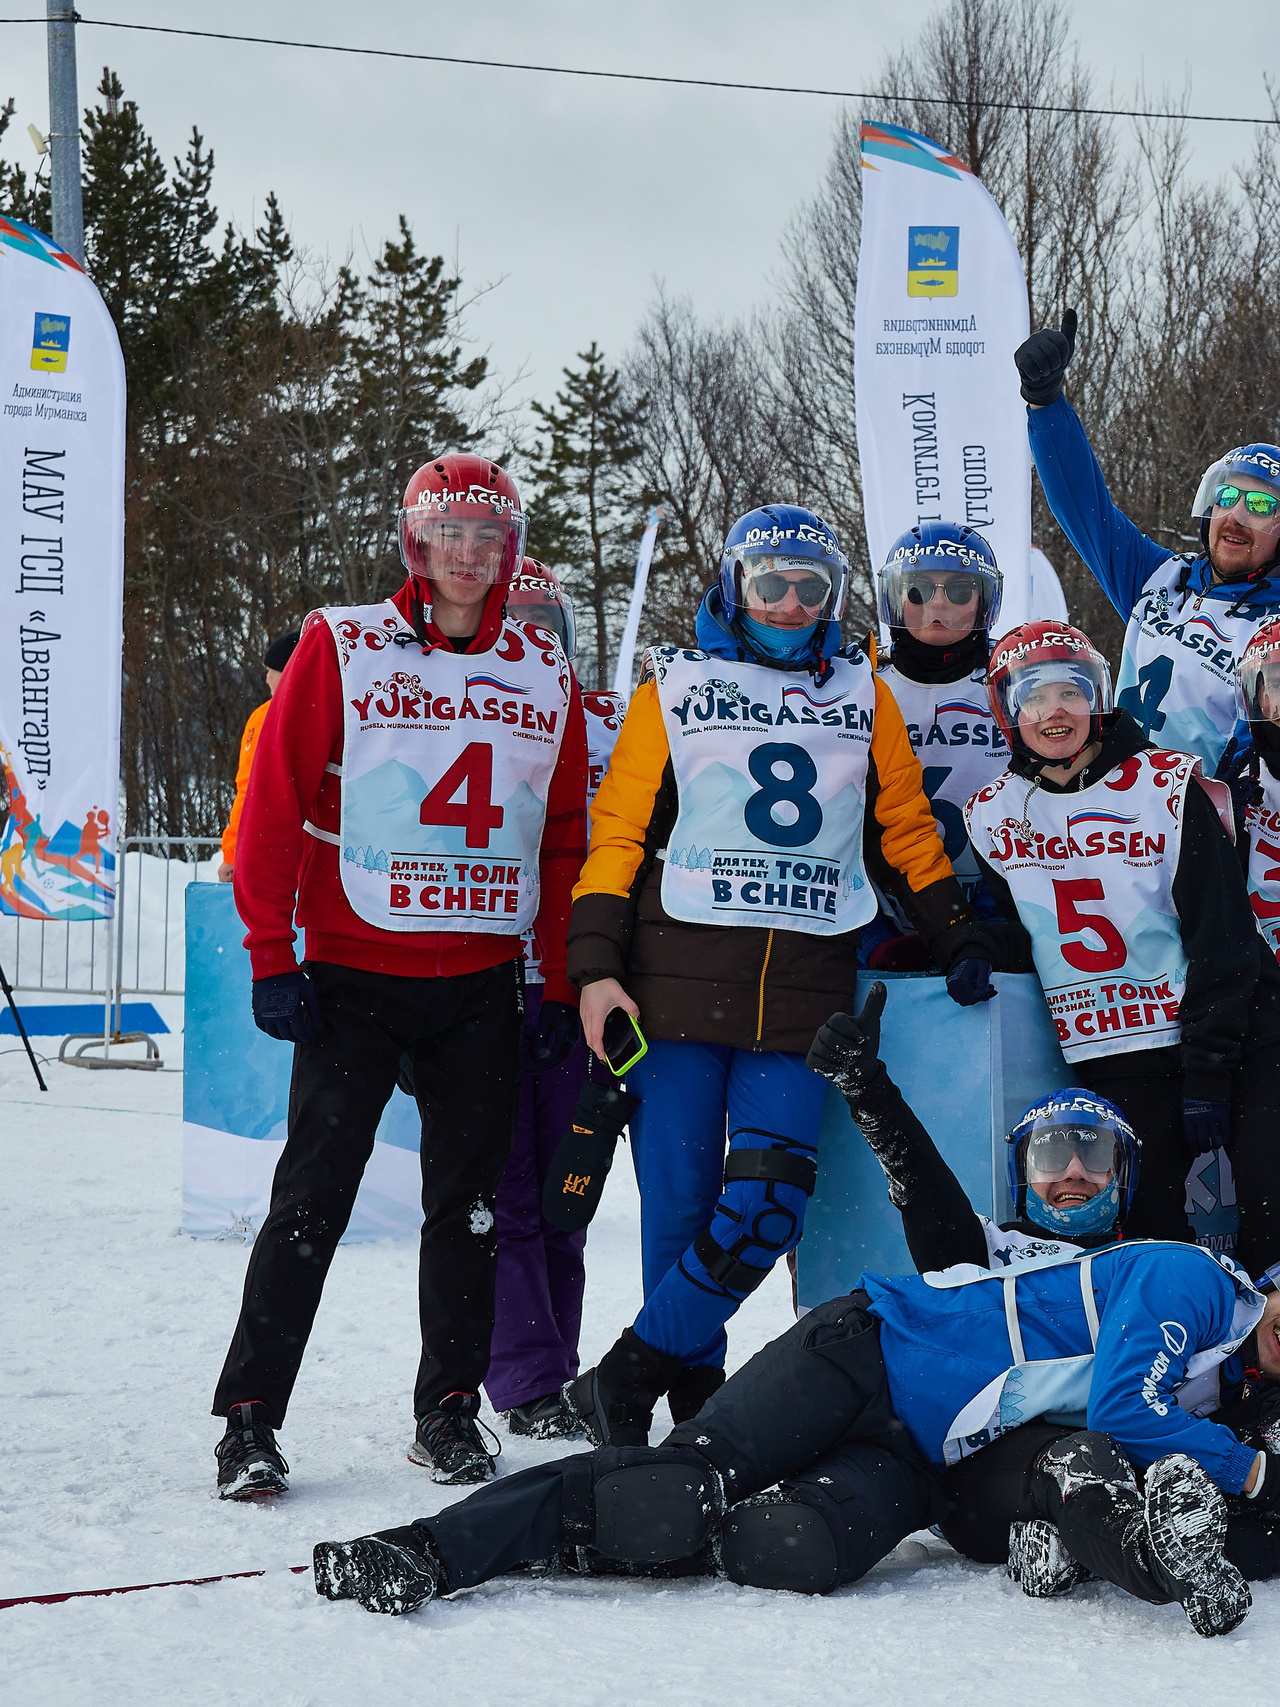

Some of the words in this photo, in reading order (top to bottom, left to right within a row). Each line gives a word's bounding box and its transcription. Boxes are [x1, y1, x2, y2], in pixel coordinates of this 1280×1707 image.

[12, 382, 83, 404] Администрация
[3, 403, 33, 418] города
[34, 402, 88, 423] Мурманска
[22, 446, 66, 524] МАУ
[15, 534, 64, 595] ГСЦ
[19, 608, 62, 792] «Авангард»
[1117, 654, 1175, 732] 4
[419, 742, 504, 849] 4
[743, 742, 824, 848] 8
[390, 861, 419, 873] ДЛЯ
[420, 862, 449, 874] ТЕХ,
[454, 863, 521, 885] ТОЛК
[712, 856, 741, 868] ДЛЯ
[741, 857, 770, 870] ТЕХ,
[712, 868, 733, 876] КТО
[734, 869, 769, 879] ЗНАЕТ
[775, 860, 840, 888] ТОЛК
[390, 873, 412, 881] КТО
[413, 873, 448, 882] ЗНАЕТ
[390, 884, 411, 908] В
[419, 885, 519, 913] СНЕГЕ
[712, 879, 733, 903] В
[740, 881, 837, 916] СНЕГЕ
[1051, 878, 1127, 973] 5
[1067, 989, 1095, 1005] ТЕХ,
[1100, 980, 1175, 1003] ТОЛК
[1065, 999, 1097, 1014] ЗНАЕТ
[1074, 1001, 1180, 1036] СНЕГЕ
